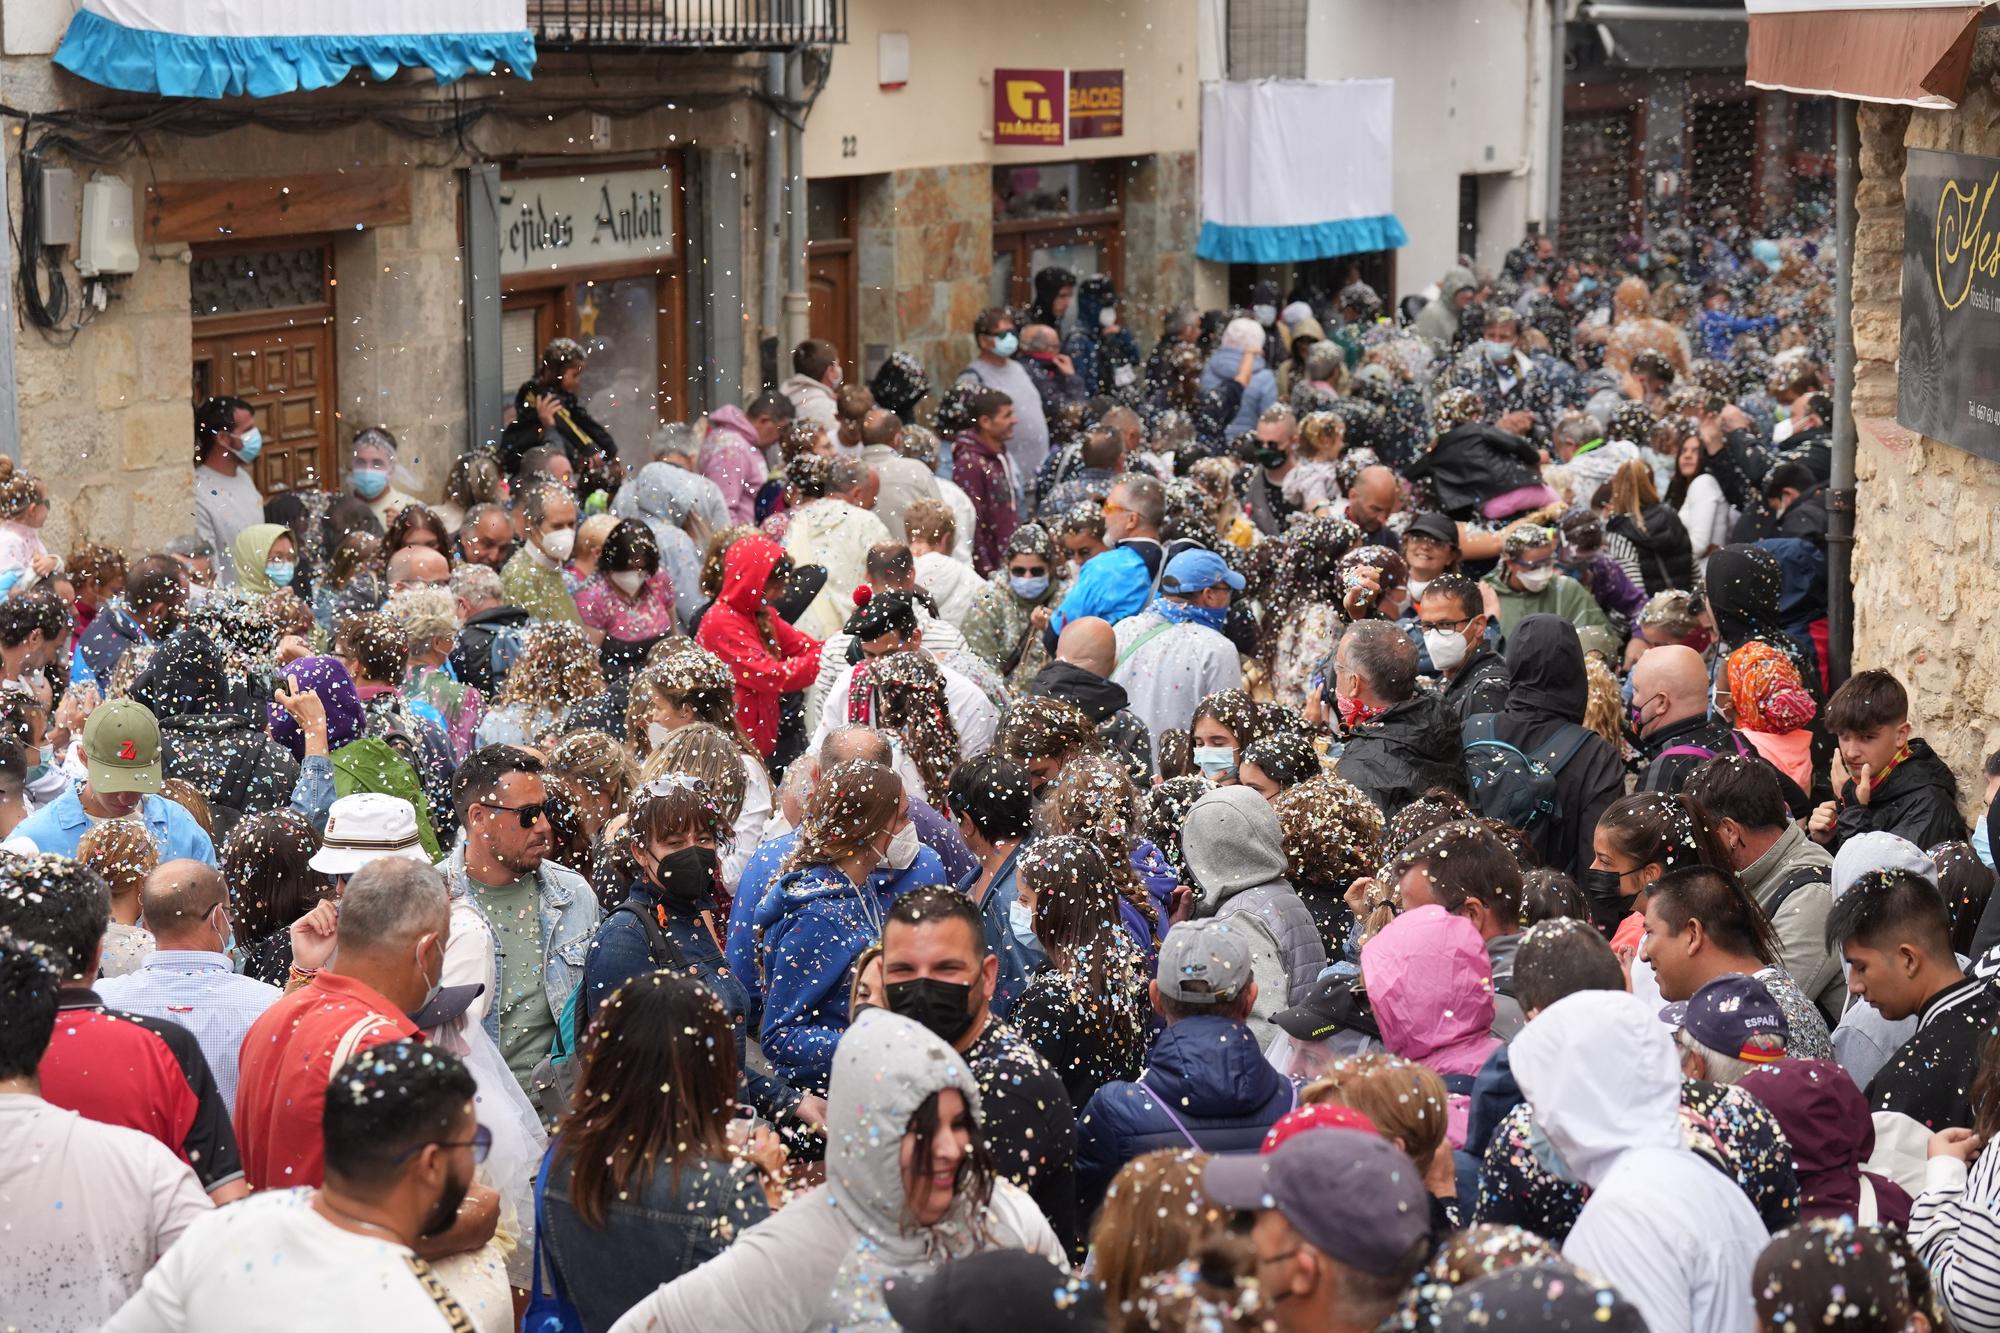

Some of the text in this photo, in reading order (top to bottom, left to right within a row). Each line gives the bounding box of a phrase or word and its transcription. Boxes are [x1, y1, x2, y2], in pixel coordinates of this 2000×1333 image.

[997, 122, 1061, 136] TABACOS
[842, 136, 858, 159] 22
[1744, 1014, 1779, 1029] ESPAÑA
[1312, 1024, 1335, 1036] ARTENGO
